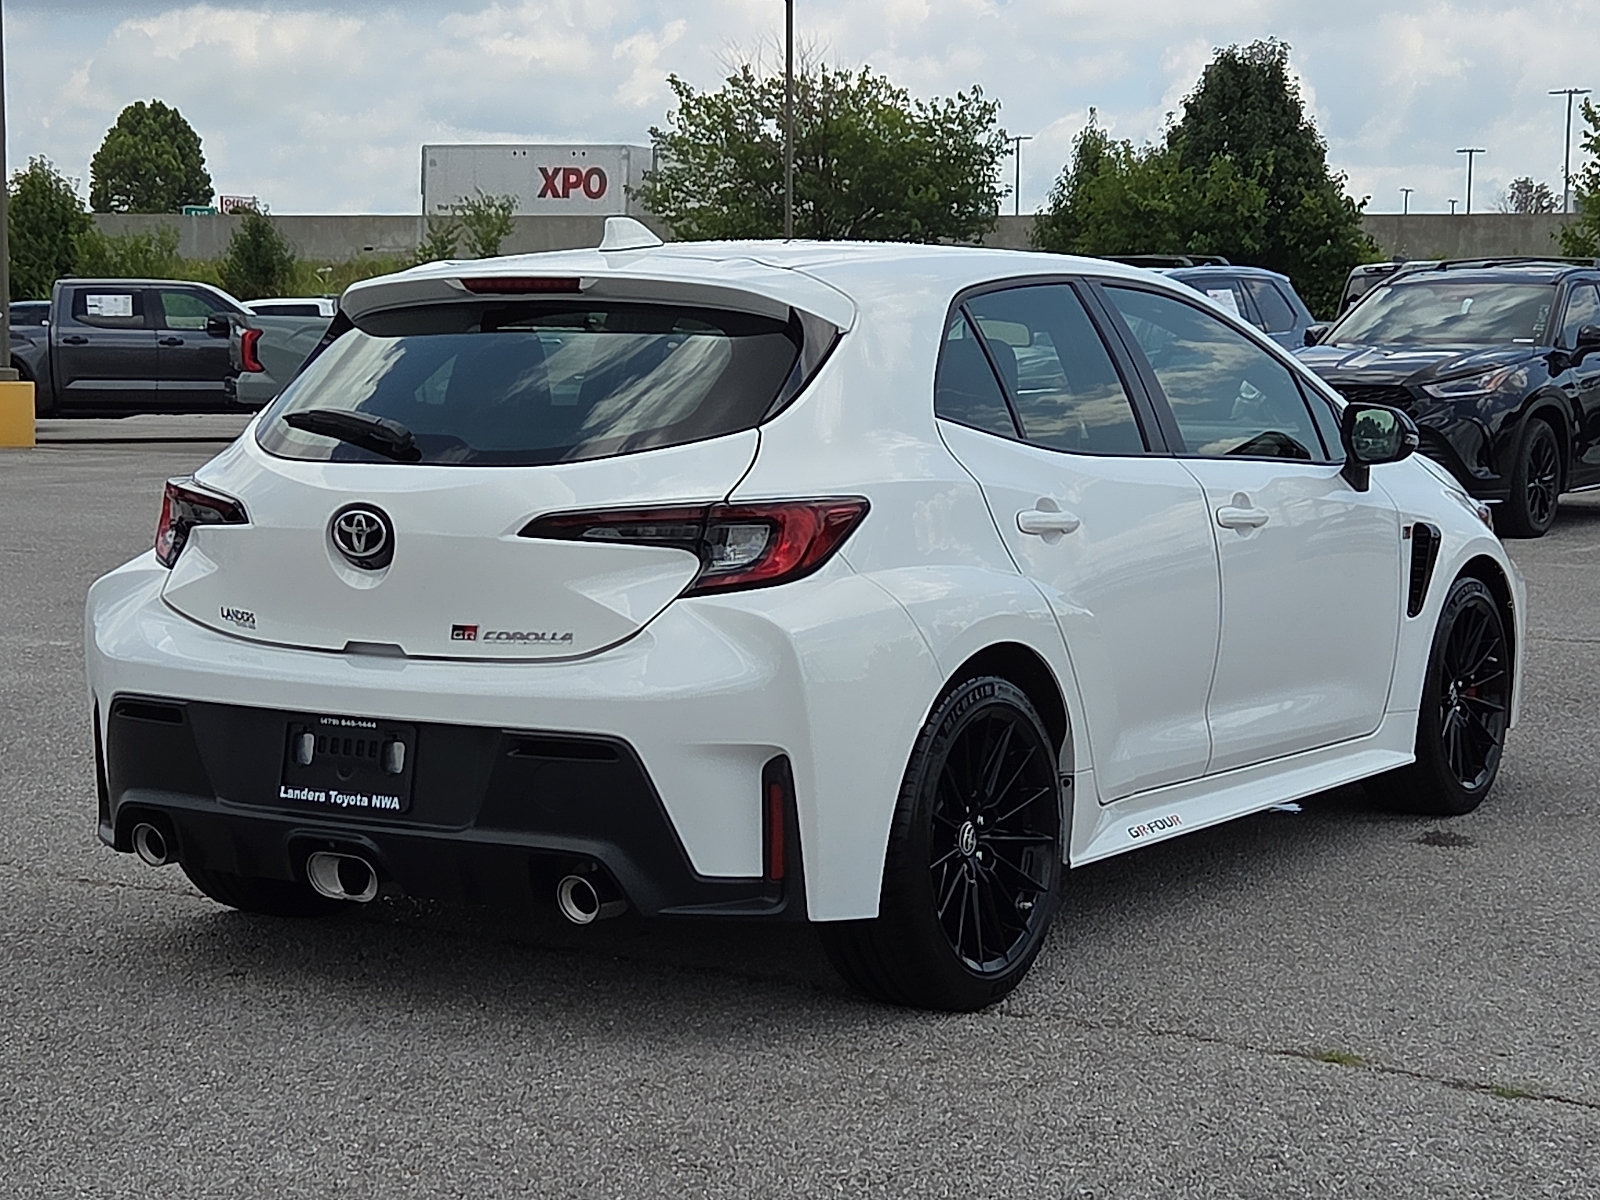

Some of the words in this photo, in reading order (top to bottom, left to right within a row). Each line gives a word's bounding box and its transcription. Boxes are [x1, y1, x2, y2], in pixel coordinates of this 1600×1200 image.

[537, 166, 608, 200] XPO
[483, 631, 573, 641] COROLLA
[943, 684, 993, 734] MICHELIN
[280, 785, 326, 802] Landers
[329, 790, 369, 807] Toyota
[371, 794, 400, 810] NWA
